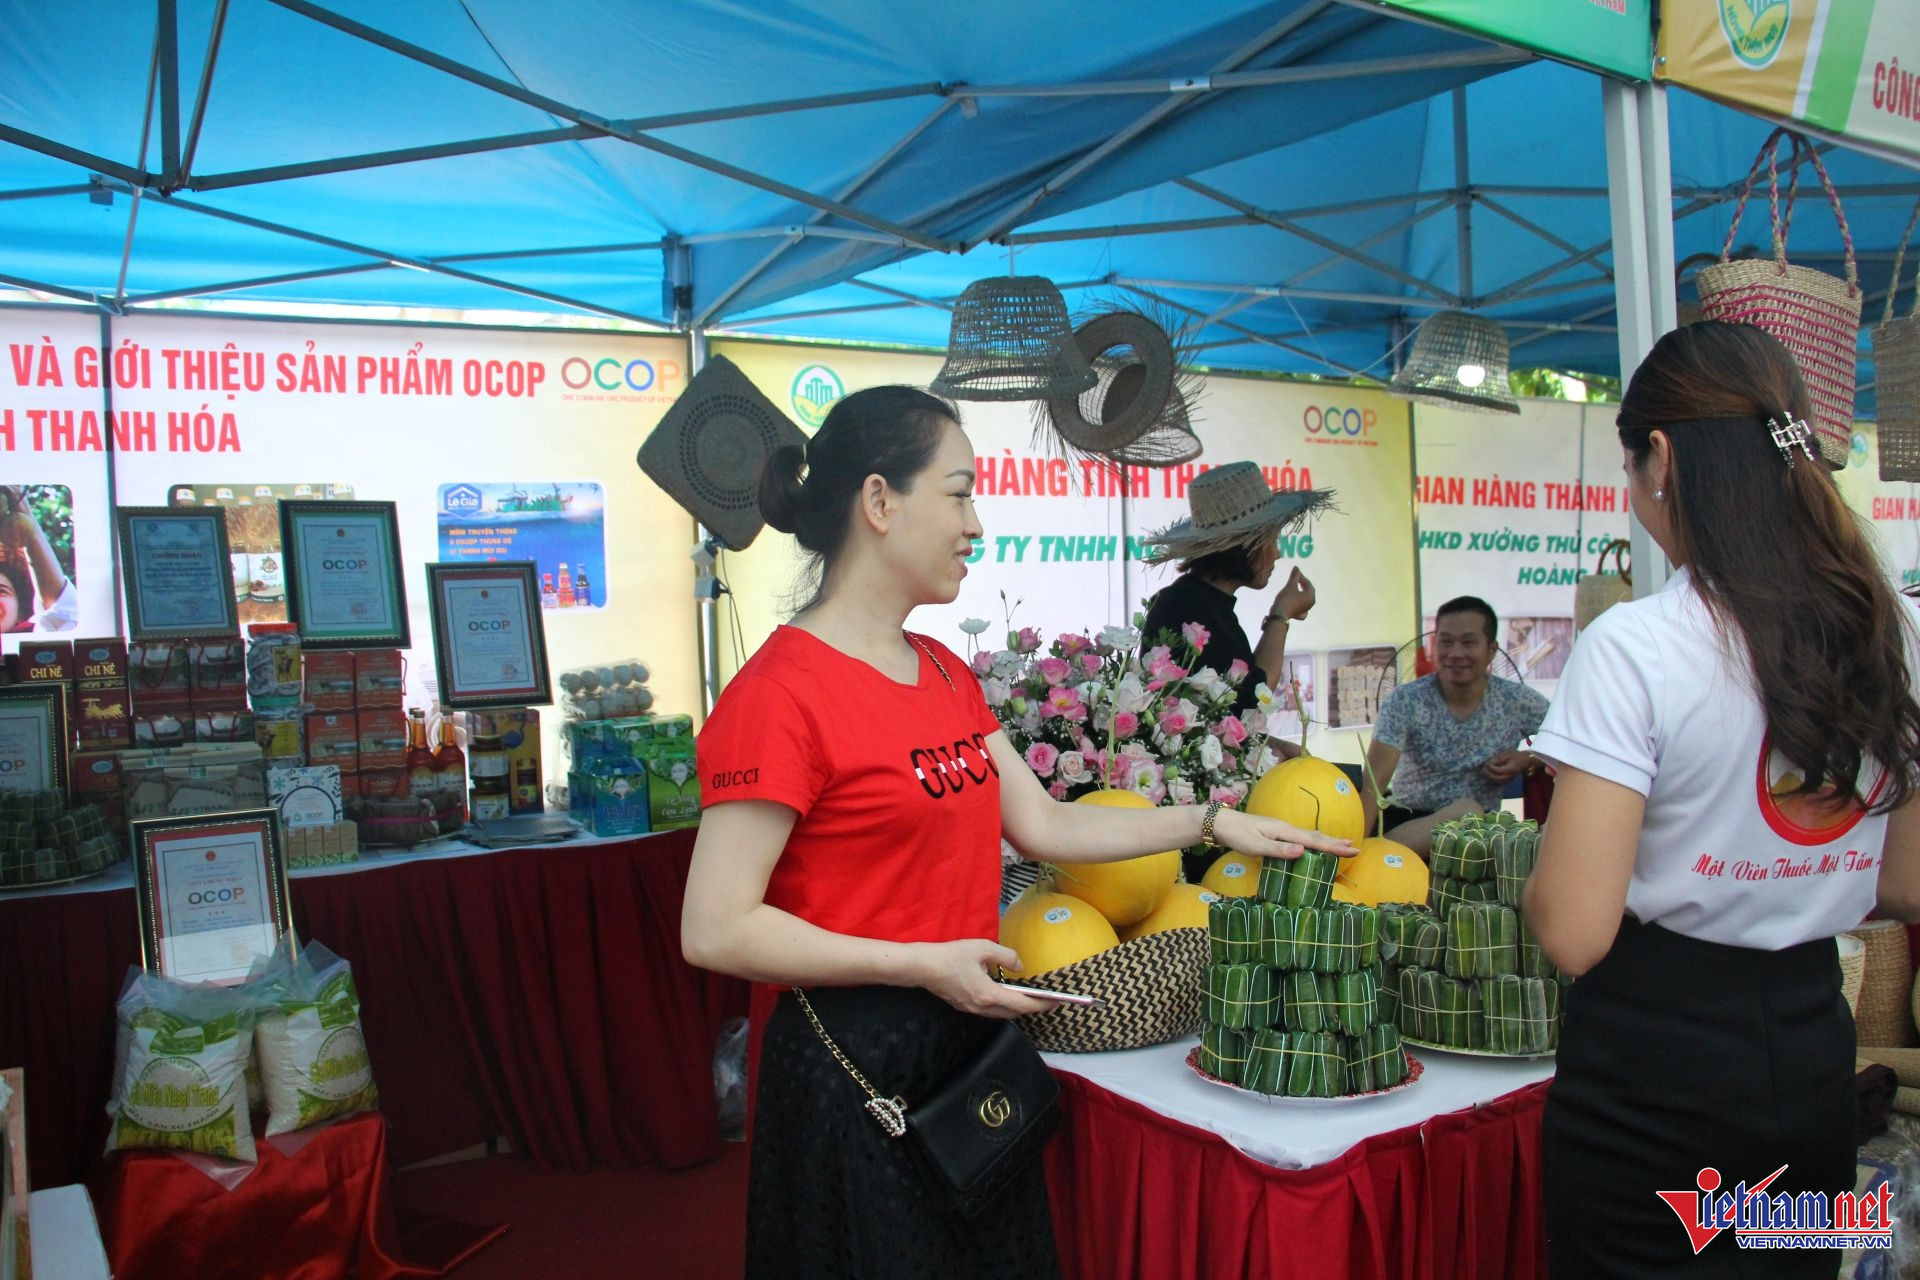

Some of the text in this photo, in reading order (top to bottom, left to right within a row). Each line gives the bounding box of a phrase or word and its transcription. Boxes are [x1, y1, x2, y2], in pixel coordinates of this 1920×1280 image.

[9, 336, 546, 400] VÀ GIỚI THIỆU SẢN PHẨM OCOP
[561, 356, 681, 391] OCOP
[26, 409, 157, 452] THANH
[167, 404, 241, 452] HÓA
[1303, 405, 1377, 437] OCOP
[974, 448, 1068, 497] HÀNG
[1472, 474, 1536, 509] HÀNG
[1873, 496, 1904, 520] GIAN
[995, 535, 1032, 563] TY
[1038, 535, 1119, 563] TNHH
[1418, 530, 1463, 551] HKD
[1467, 526, 1540, 552] XƯỞNG
[322, 559, 368, 571] OCOP
[468, 619, 511, 632] OCOP
[30, 667, 47, 679] CHI
[84, 664, 101, 677] CHI
[711, 767, 760, 790] GUCCI
[1691, 852, 1726, 881] Một
[1731, 859, 1768, 881] Viên
[188, 886, 245, 905] OCOP
